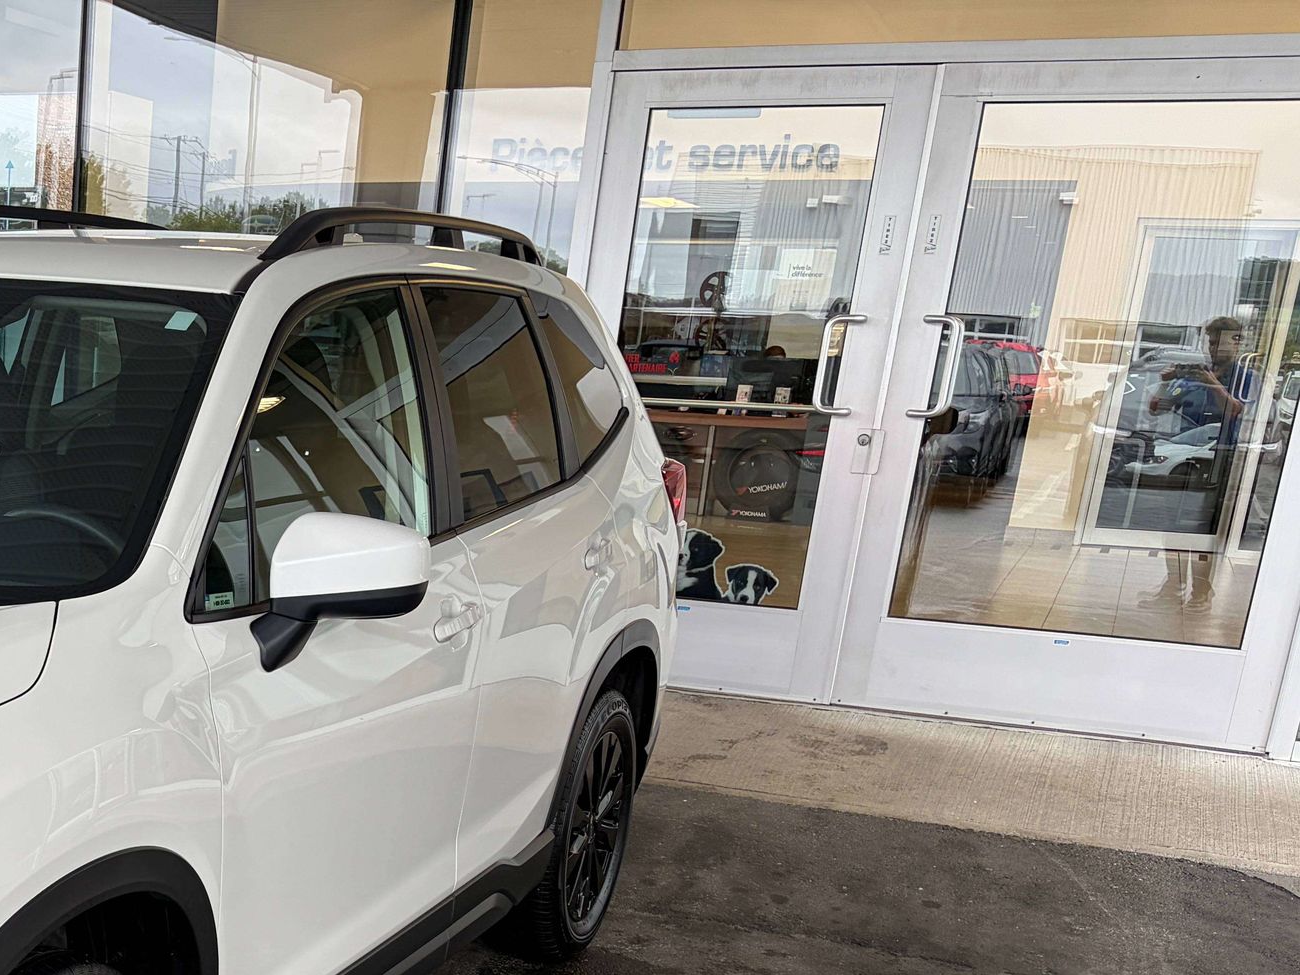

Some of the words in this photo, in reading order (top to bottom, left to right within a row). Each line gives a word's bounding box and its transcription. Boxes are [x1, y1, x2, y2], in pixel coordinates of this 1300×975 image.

[491, 138, 583, 172] Pièce
[687, 134, 840, 173] service
[629, 363, 668, 373] ARTENAIRE
